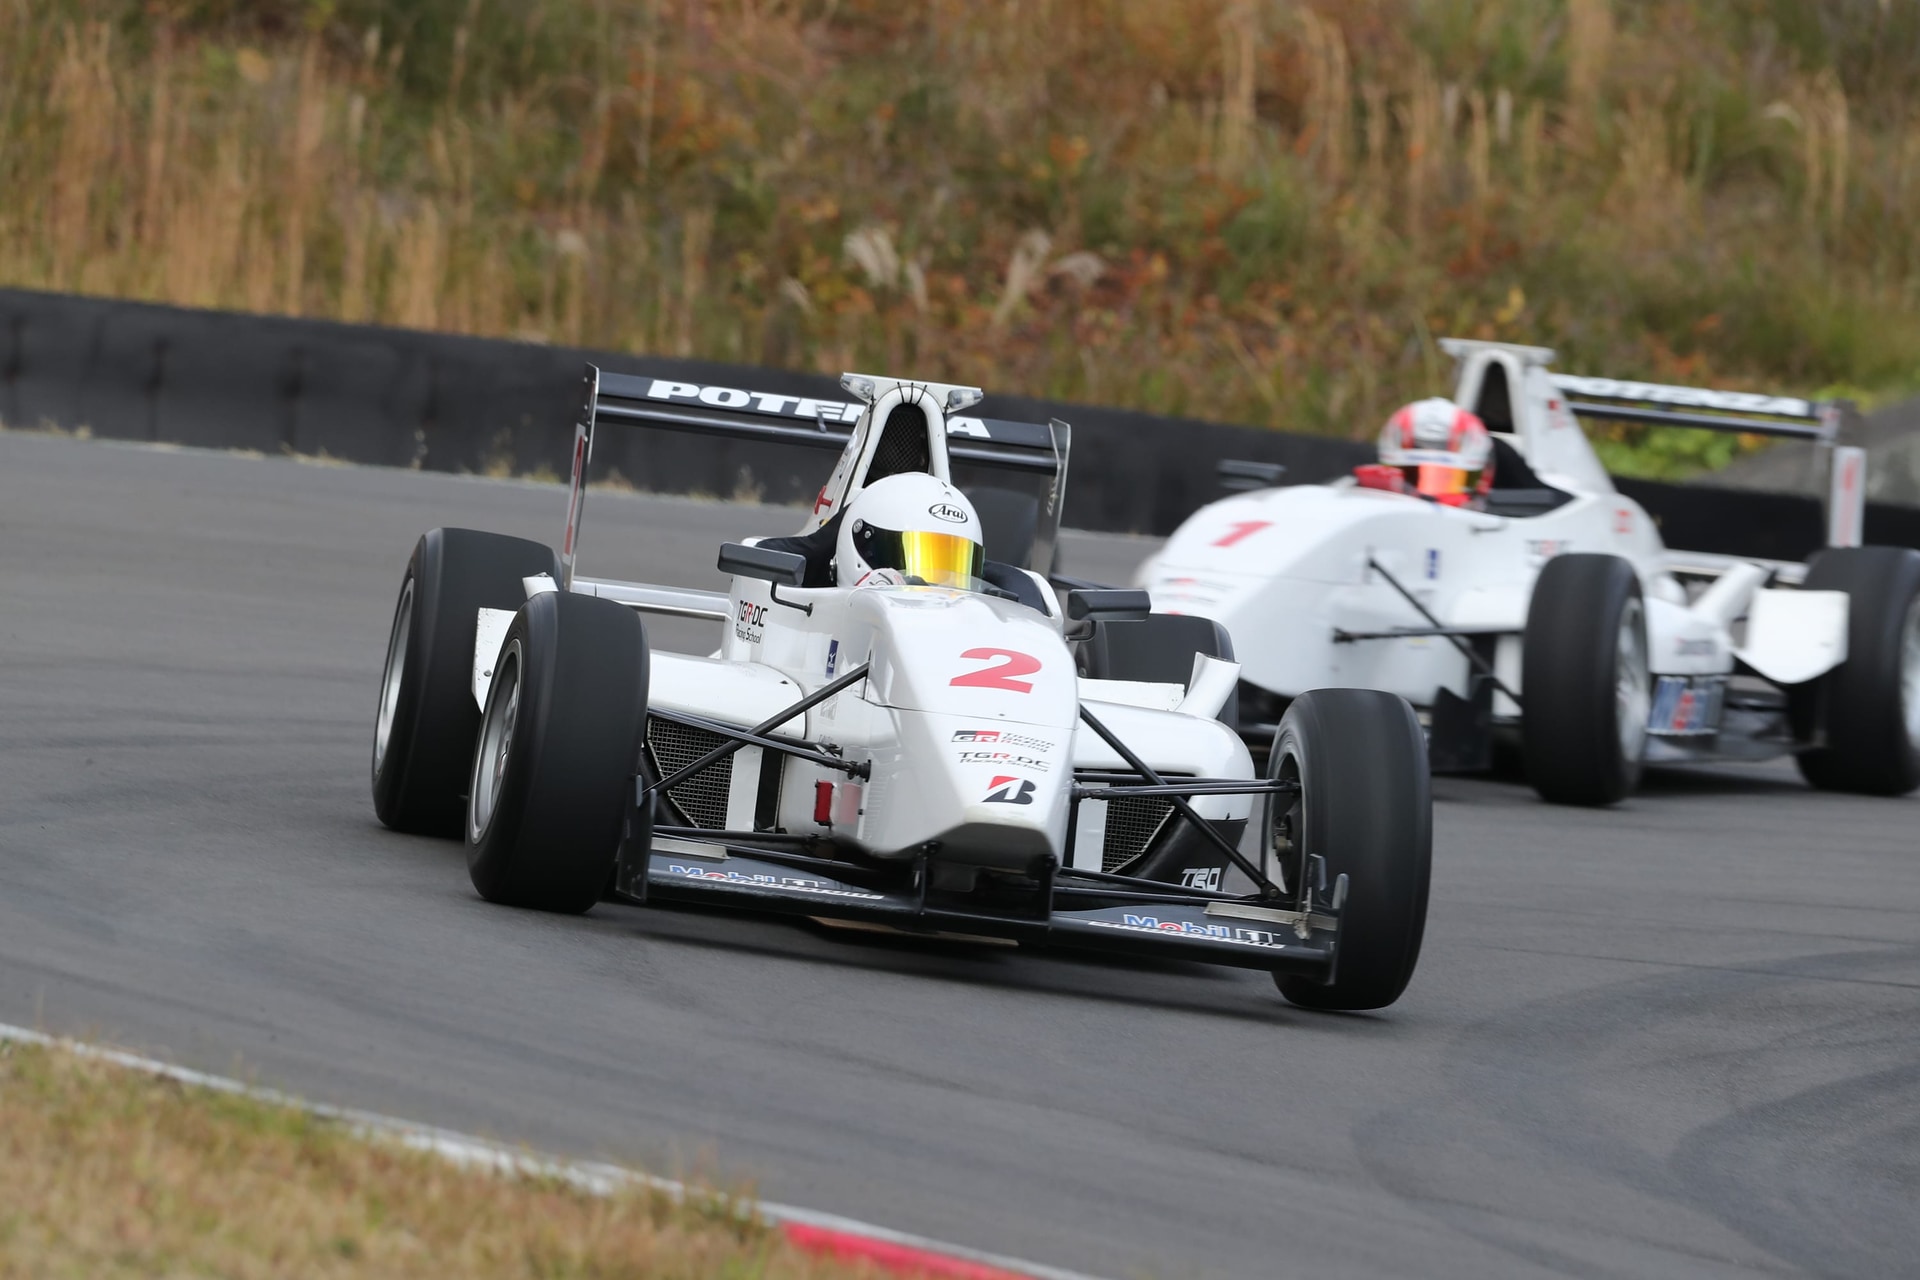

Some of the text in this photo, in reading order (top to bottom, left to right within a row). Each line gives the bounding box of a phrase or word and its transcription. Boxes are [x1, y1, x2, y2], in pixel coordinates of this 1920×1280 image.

[932, 505, 965, 520] Arai
[949, 647, 1042, 694] 2
[951, 732, 1000, 742] GR
[1123, 914, 1231, 938] Mobil
